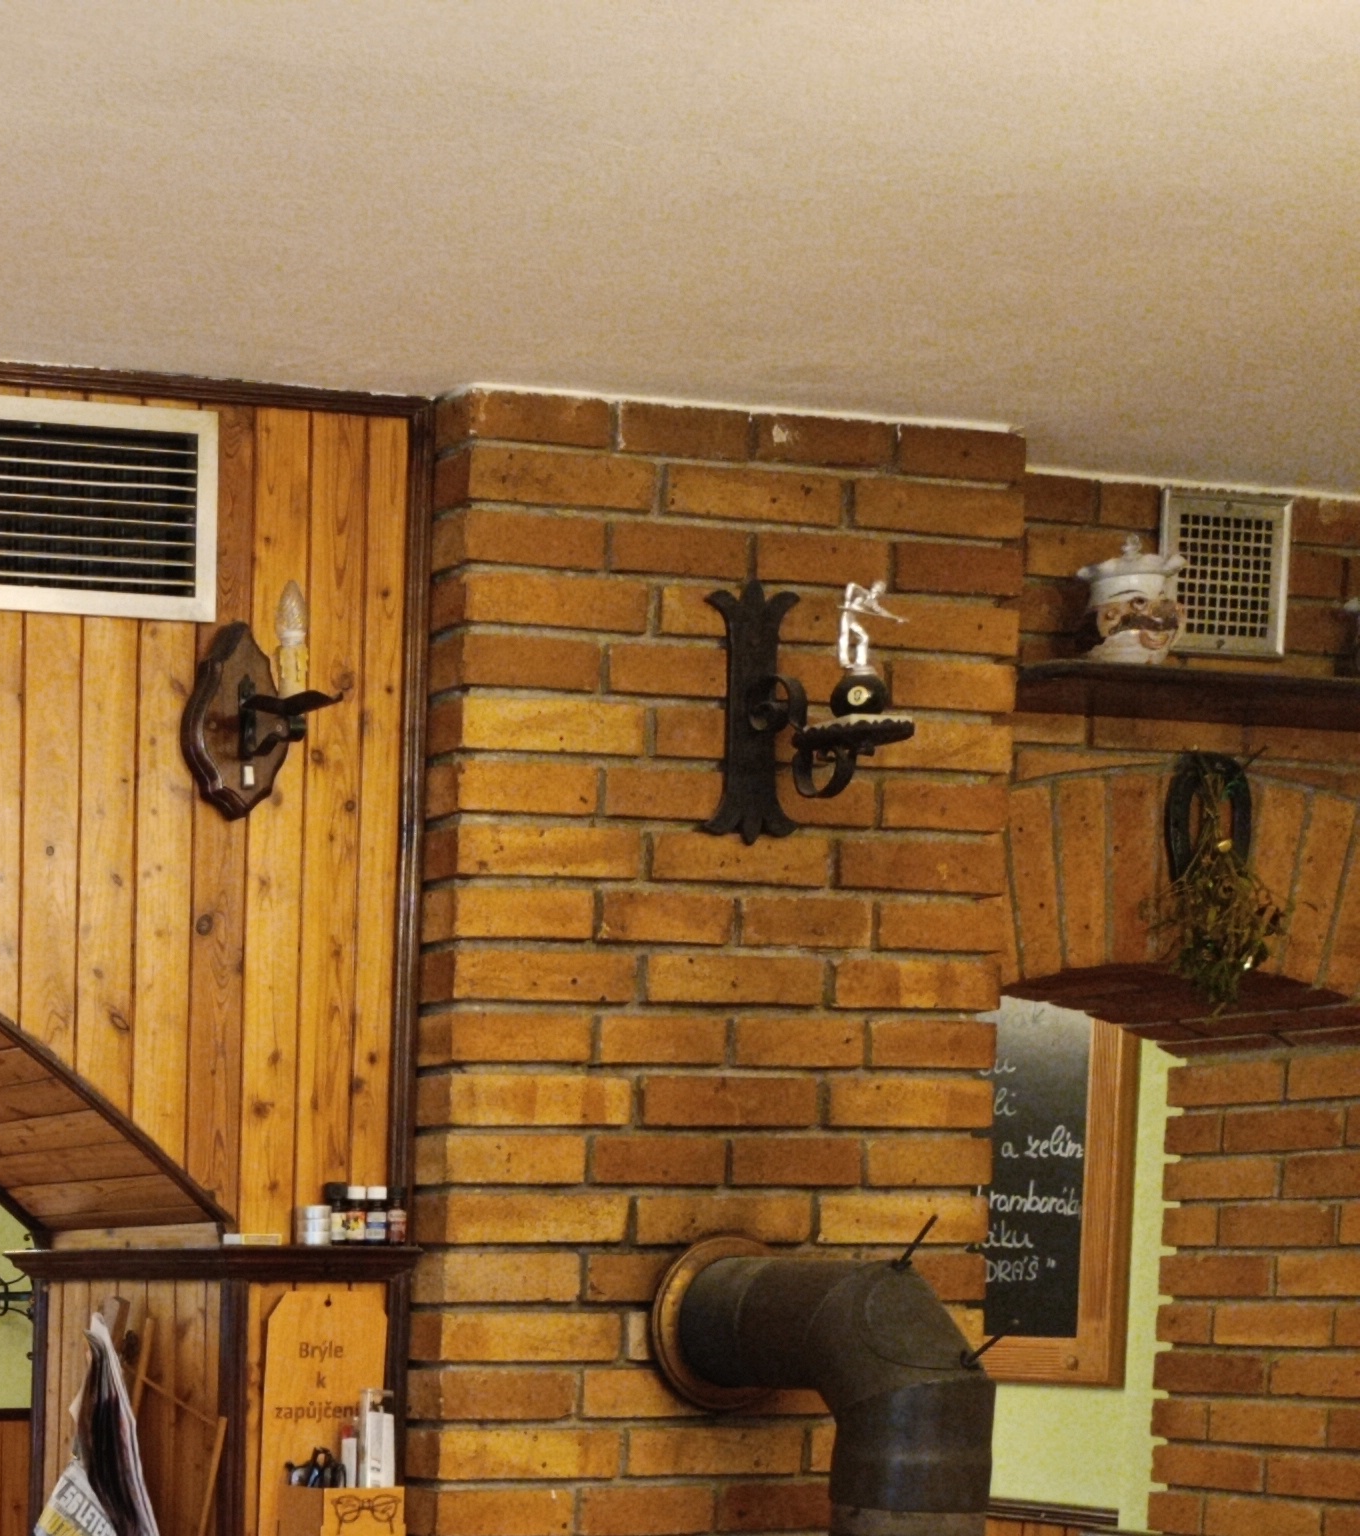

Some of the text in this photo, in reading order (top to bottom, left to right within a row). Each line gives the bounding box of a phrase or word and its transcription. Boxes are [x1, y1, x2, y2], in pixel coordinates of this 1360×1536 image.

[1001, 1141, 1019, 1158] a
[299, 1340, 344, 1362] Brýle
[316, 1371, 326, 1388] k
[275, 1401, 360, 1423] zapůjčení
